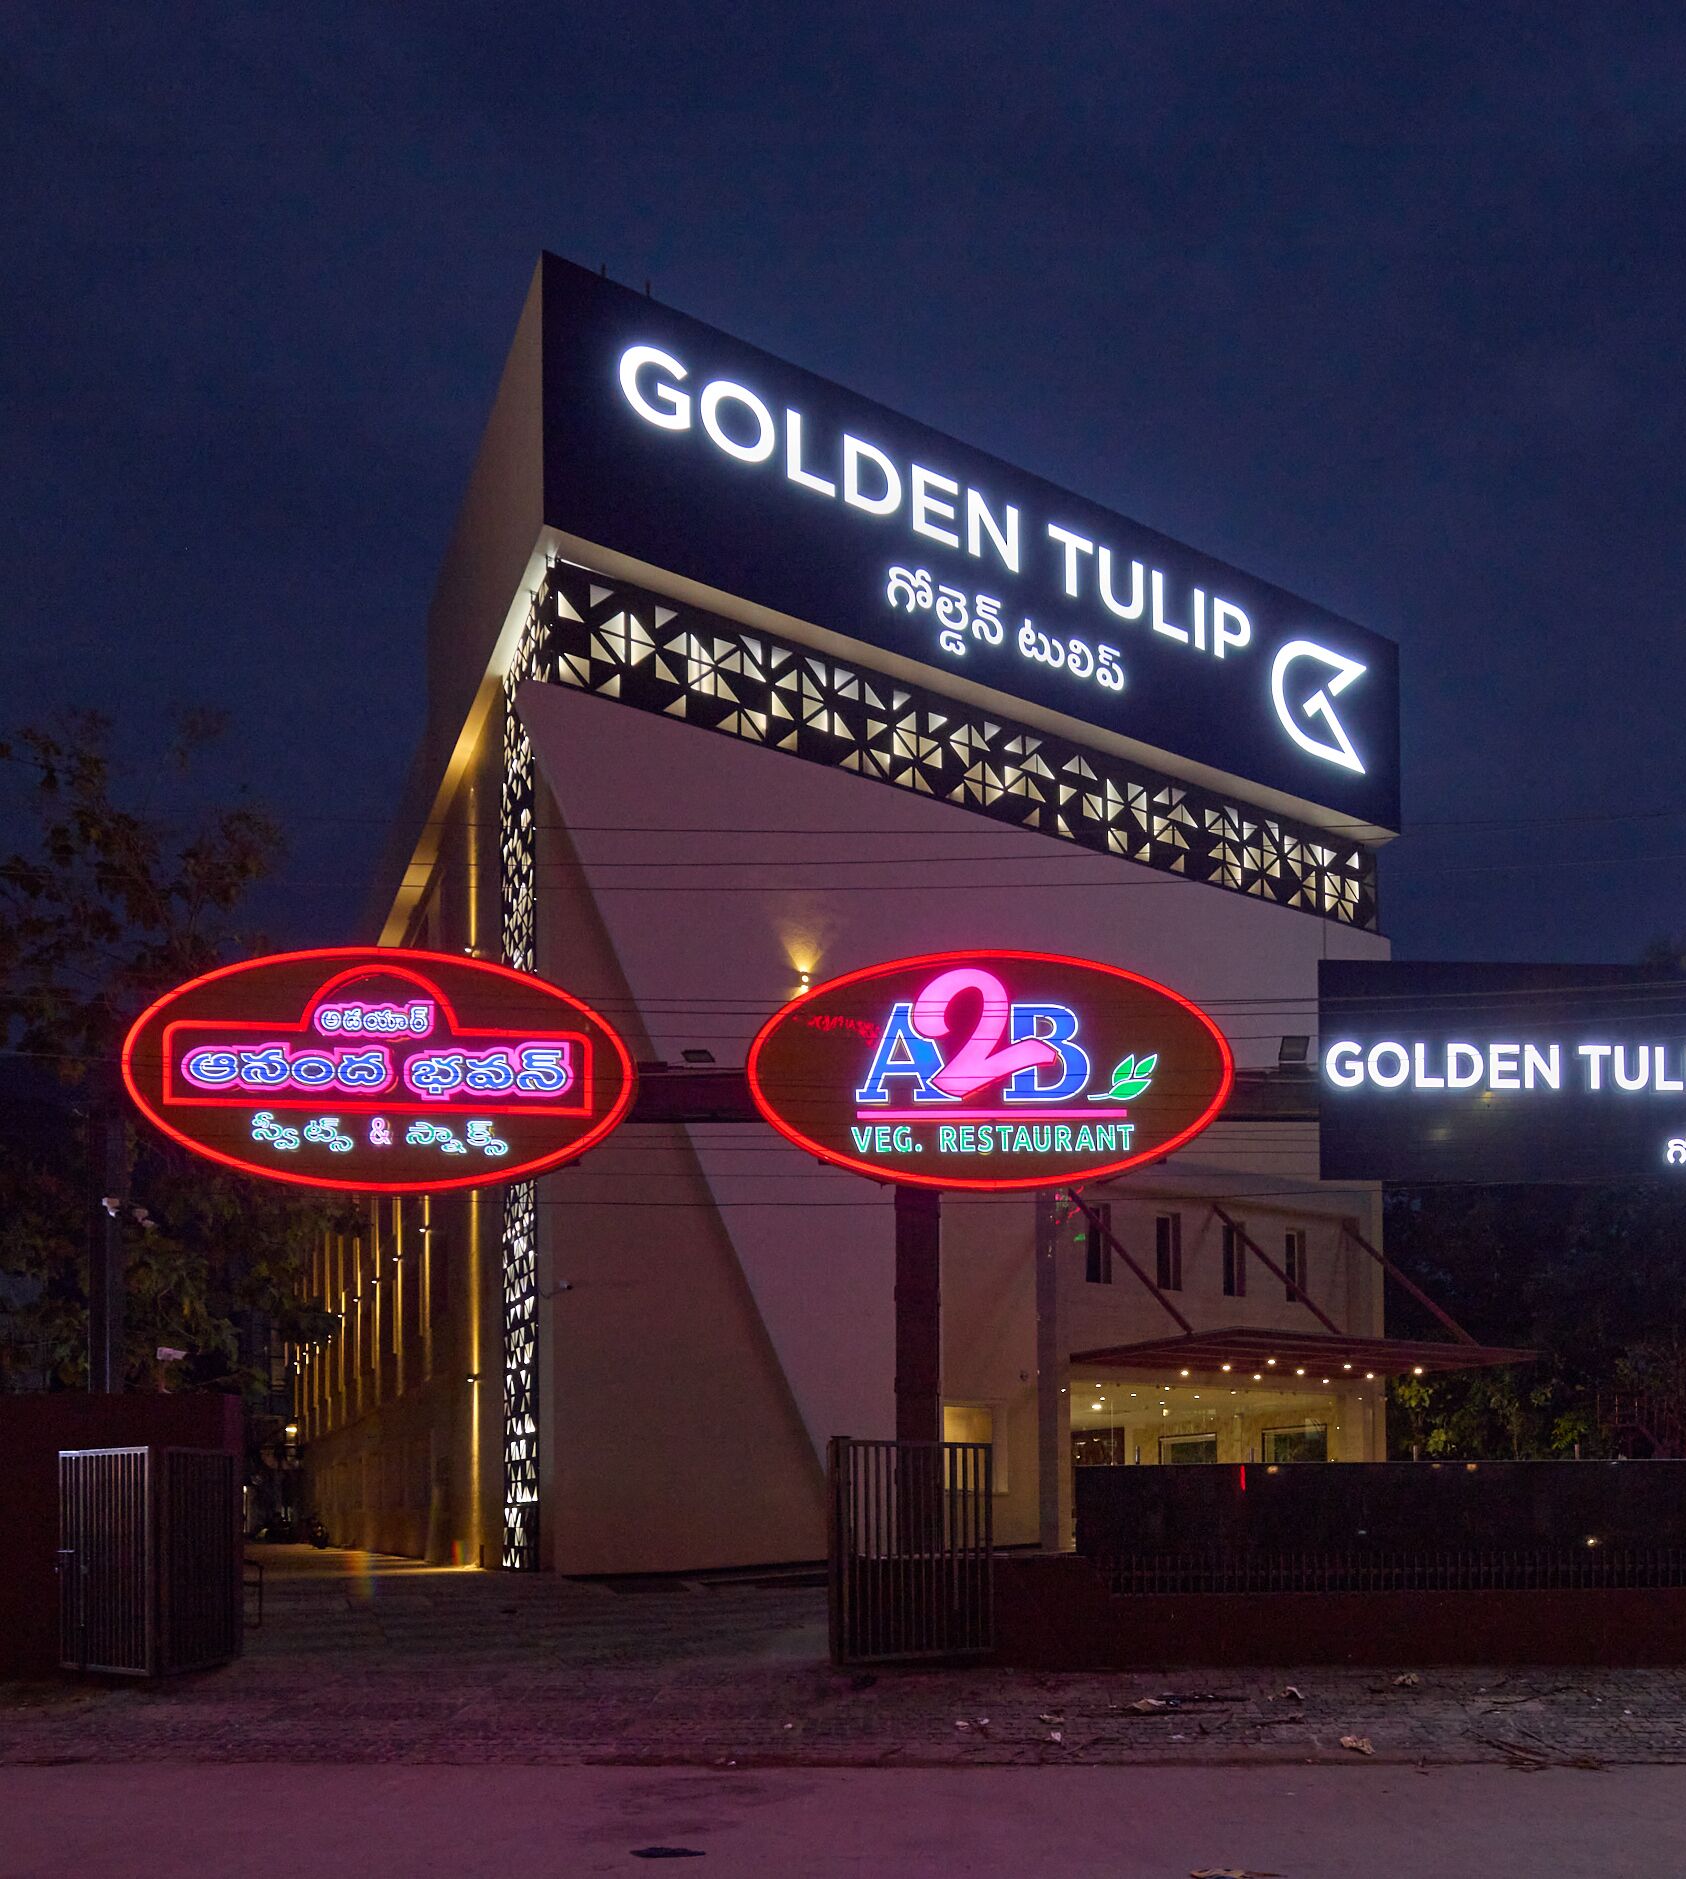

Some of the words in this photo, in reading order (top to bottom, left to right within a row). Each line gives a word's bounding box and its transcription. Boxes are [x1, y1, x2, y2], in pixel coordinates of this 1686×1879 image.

[618, 345, 1019, 573] GOLDEN
[1047, 523, 1252, 659] TULIP
[886, 565, 1004, 656] గోల్డెన్
[1018, 618, 1125, 691] టులిప్
[318, 1004, 431, 1035] అడయార్
[856, 968, 1090, 1103] A2B
[187, 1047, 387, 1088] ఆనంద
[410, 1047, 569, 1095] భవన్
[1325, 1041, 1560, 1090] GOLDEN
[251, 1112, 354, 1152] స్వీట్స్
[369, 1117, 393, 1146] &
[405, 1120, 509, 1156] స్నాక్స్
[851, 1125, 923, 1154] VEG.
[939, 1124, 1136, 1153] RESTAURANT
